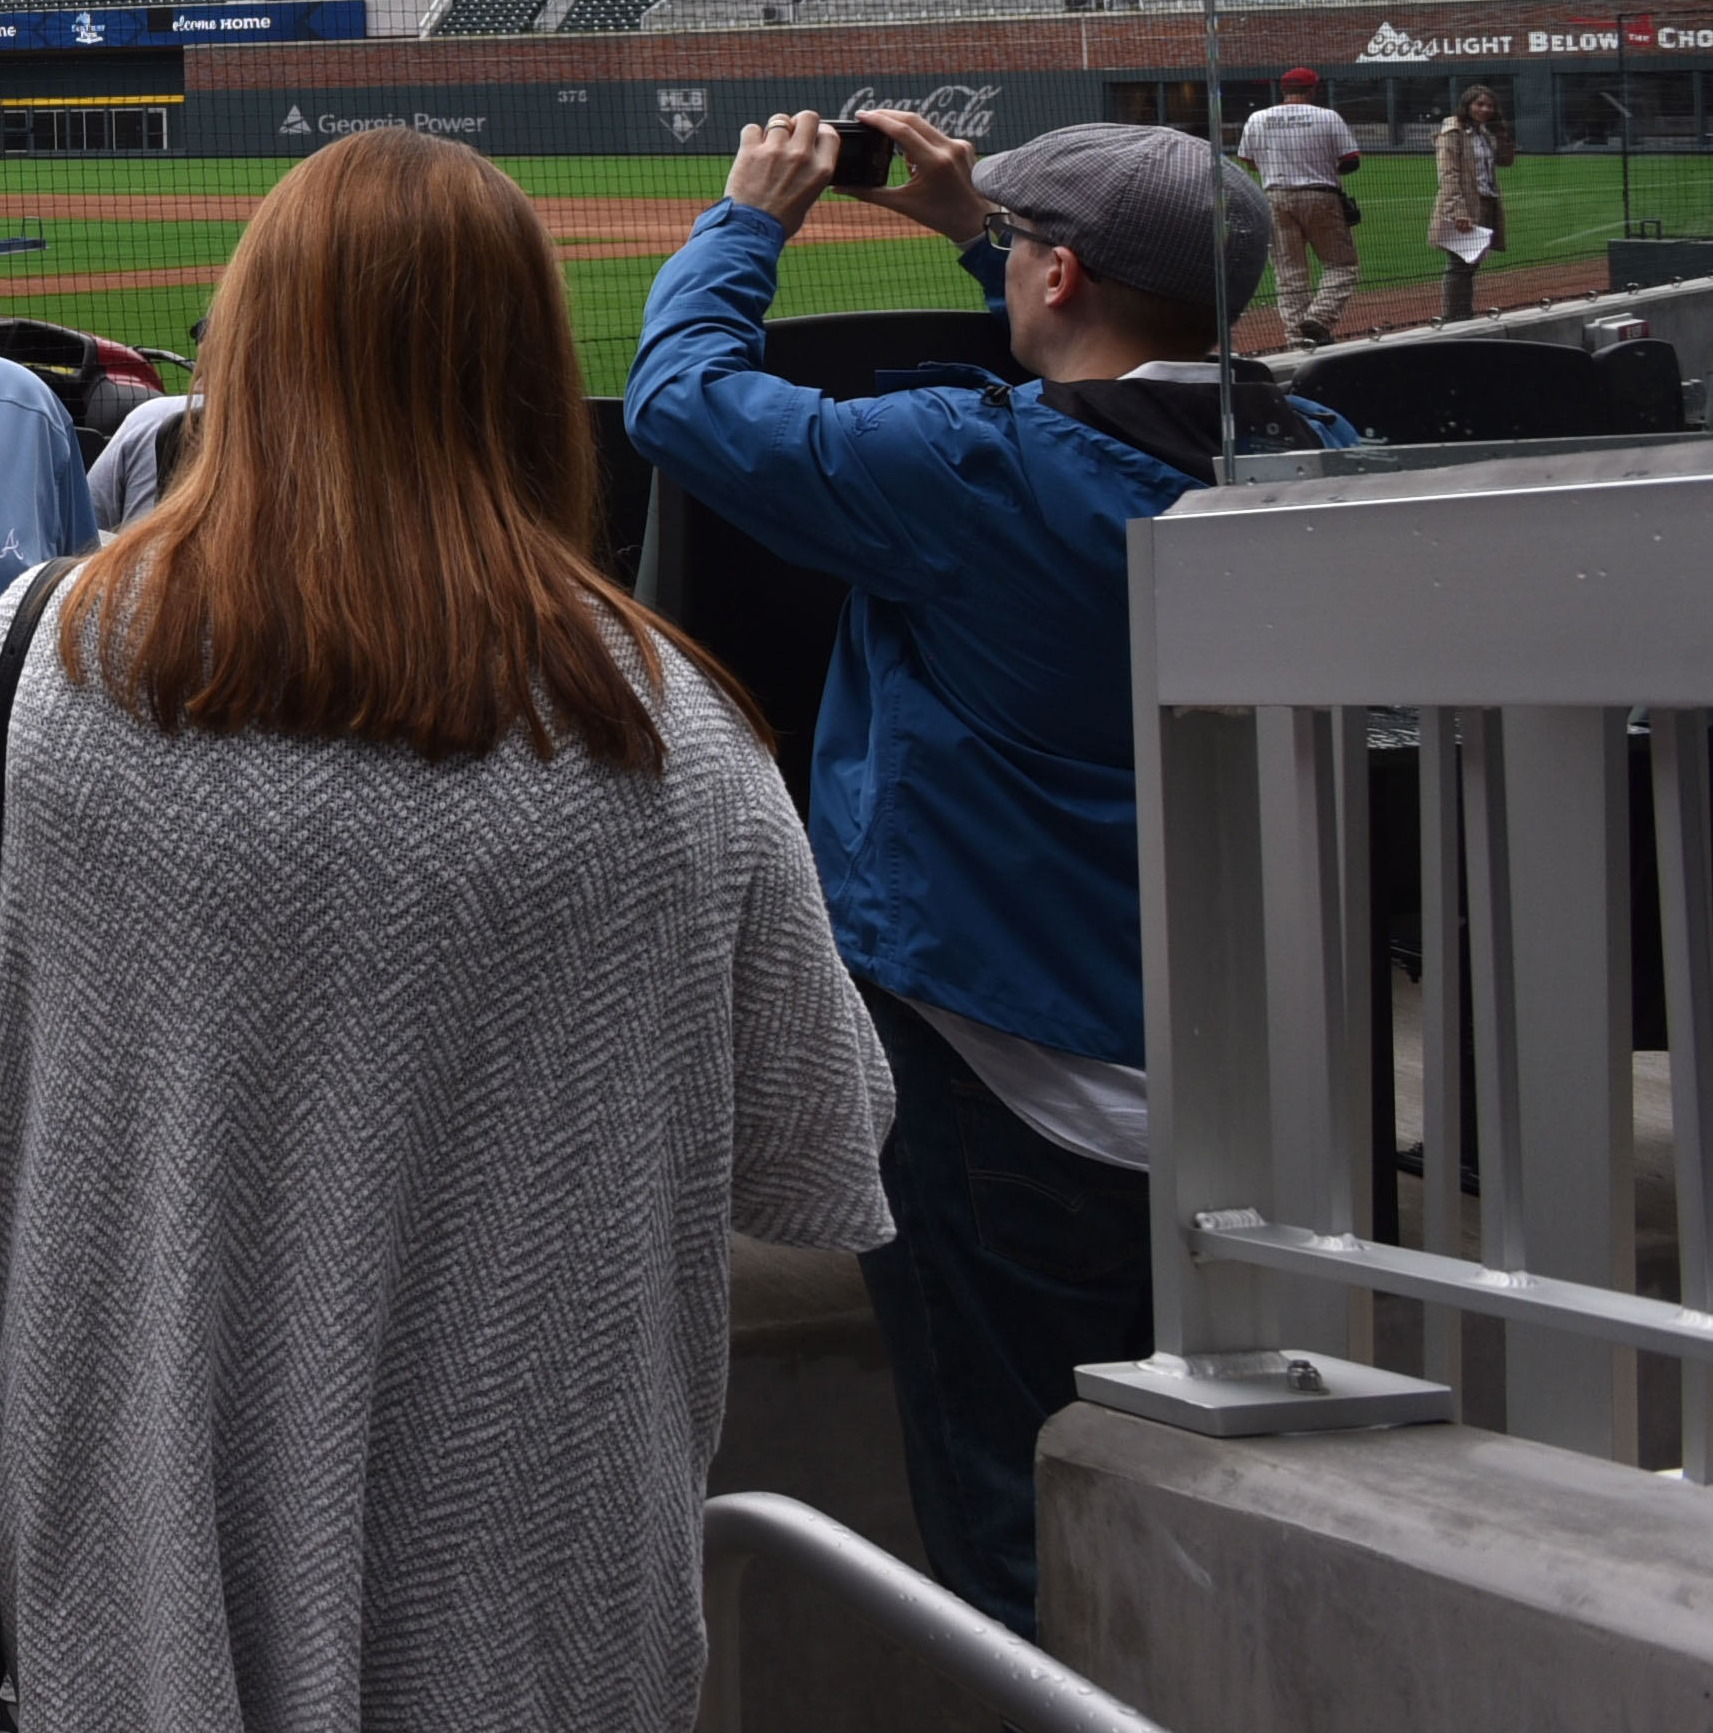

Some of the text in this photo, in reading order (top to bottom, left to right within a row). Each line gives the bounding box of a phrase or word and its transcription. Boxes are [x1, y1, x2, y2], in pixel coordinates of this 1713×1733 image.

[171, 15, 218, 33] elcome
[1443, 35, 1513, 56] LIGHT
[414, 112, 487, 134] Power
